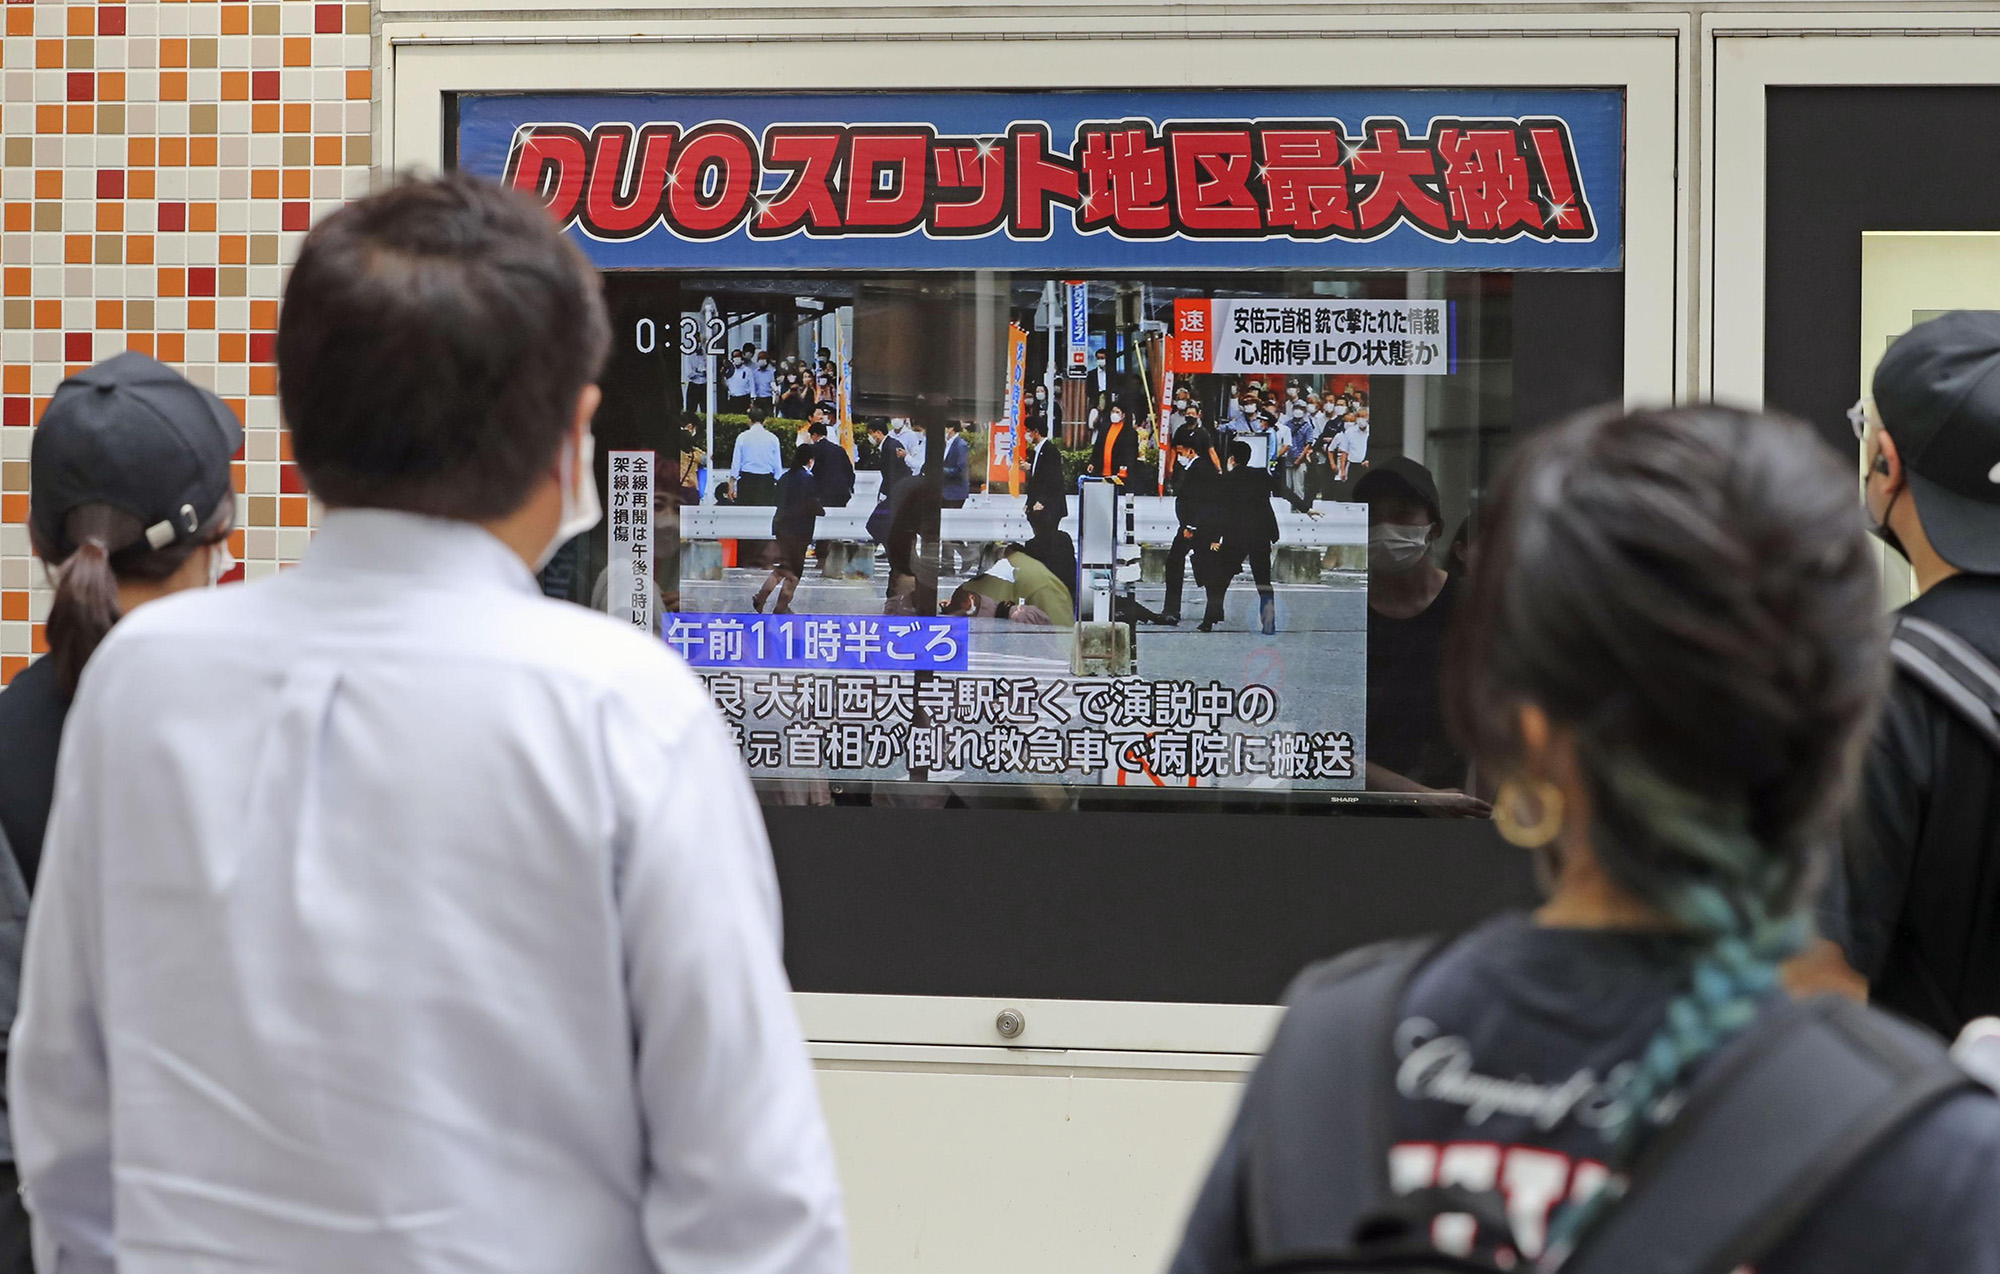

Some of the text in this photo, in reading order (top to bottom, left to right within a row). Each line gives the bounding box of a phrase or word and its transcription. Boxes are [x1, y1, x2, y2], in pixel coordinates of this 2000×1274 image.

[635, 317, 726, 355] 0:32
[1180, 310, 1204, 362] 速報
[1234, 339, 1439, 366] 心肺停止の状態か
[613, 457, 629, 542] 架線が損傷
[632, 457, 648, 632] 全線再開は午後3時以
[667, 618, 958, 663] 午前11時半ごろ
